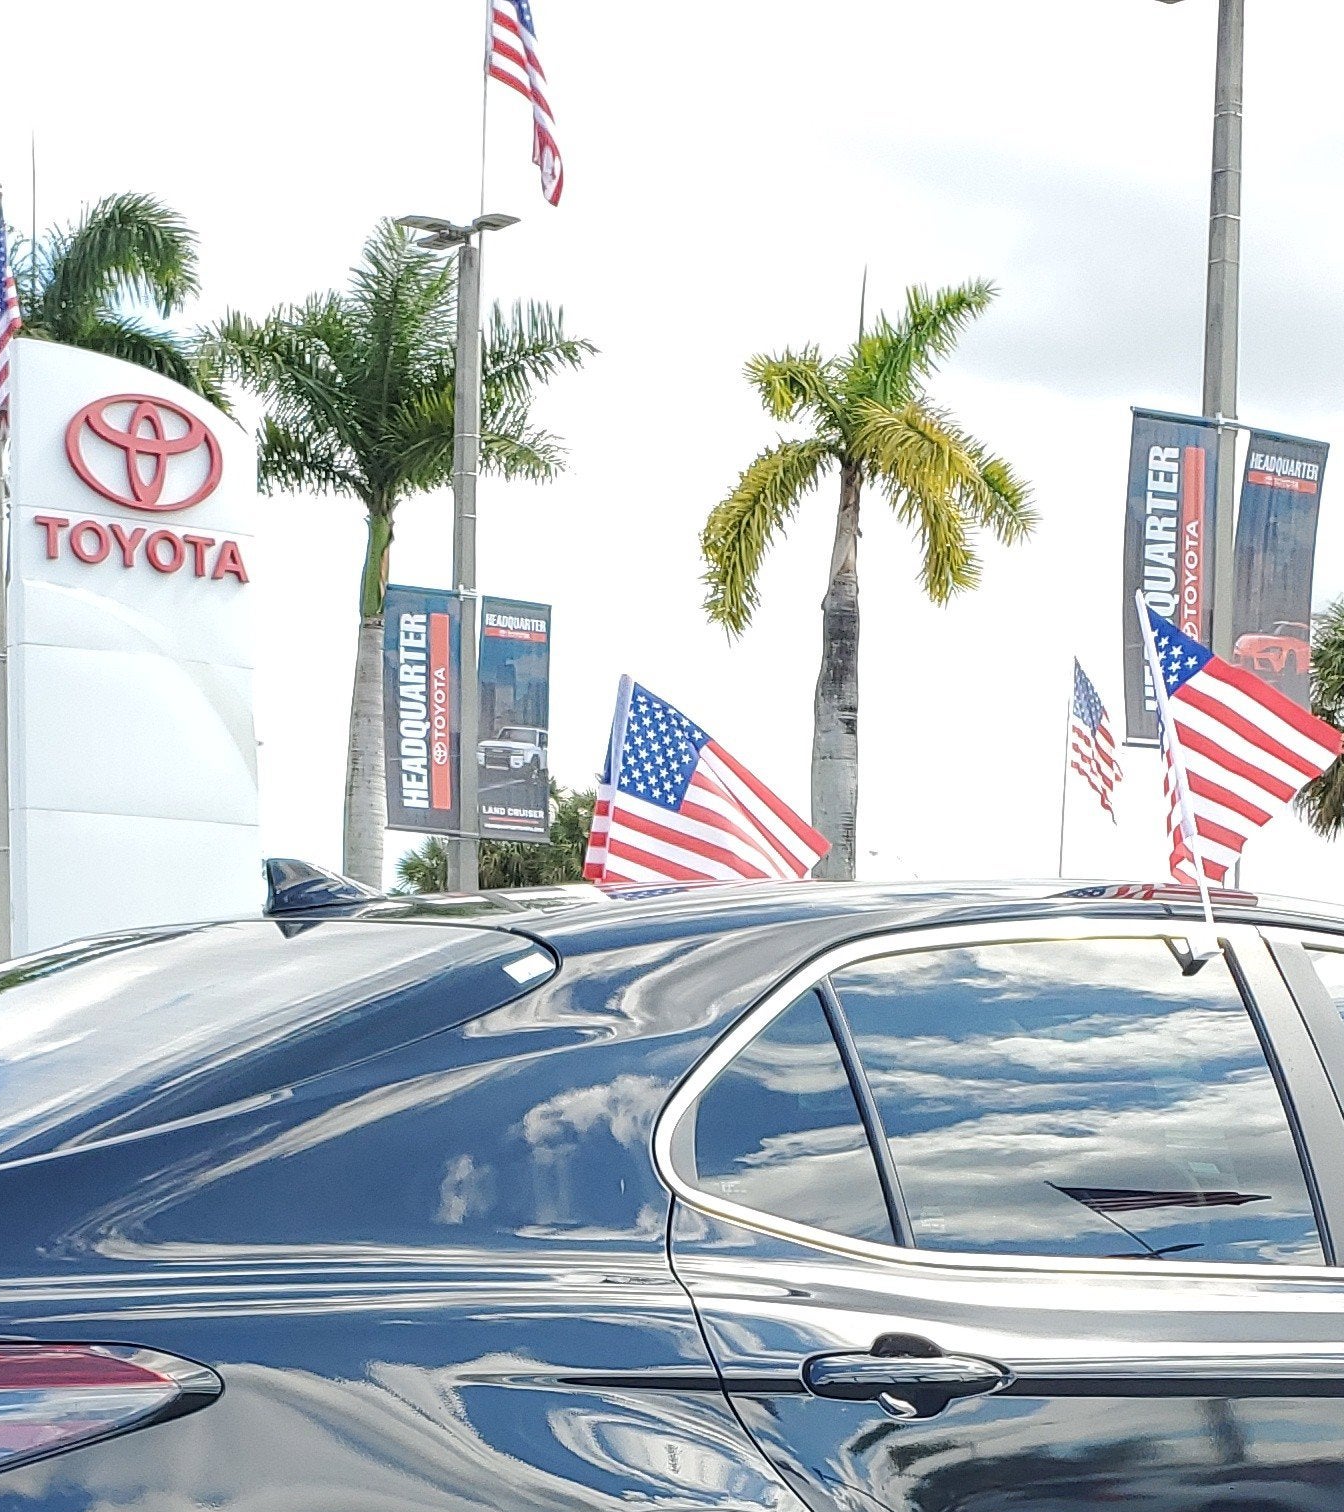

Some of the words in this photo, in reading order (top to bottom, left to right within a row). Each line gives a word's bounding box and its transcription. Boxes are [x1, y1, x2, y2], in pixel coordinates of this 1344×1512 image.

[1249, 452, 1319, 481] HEADQUARTER
[34, 514, 250, 584] TOYOTA
[1144, 445, 1182, 713] QUARTER
[1184, 520, 1199, 619] TOYOTA
[485, 613, 547, 633] HEADQUARTER
[399, 611, 431, 810] HEADQUARTER
[433, 666, 446, 741] TOYOTA
[482, 805, 506, 816] LAND
[507, 807, 545, 819] CRUISER
